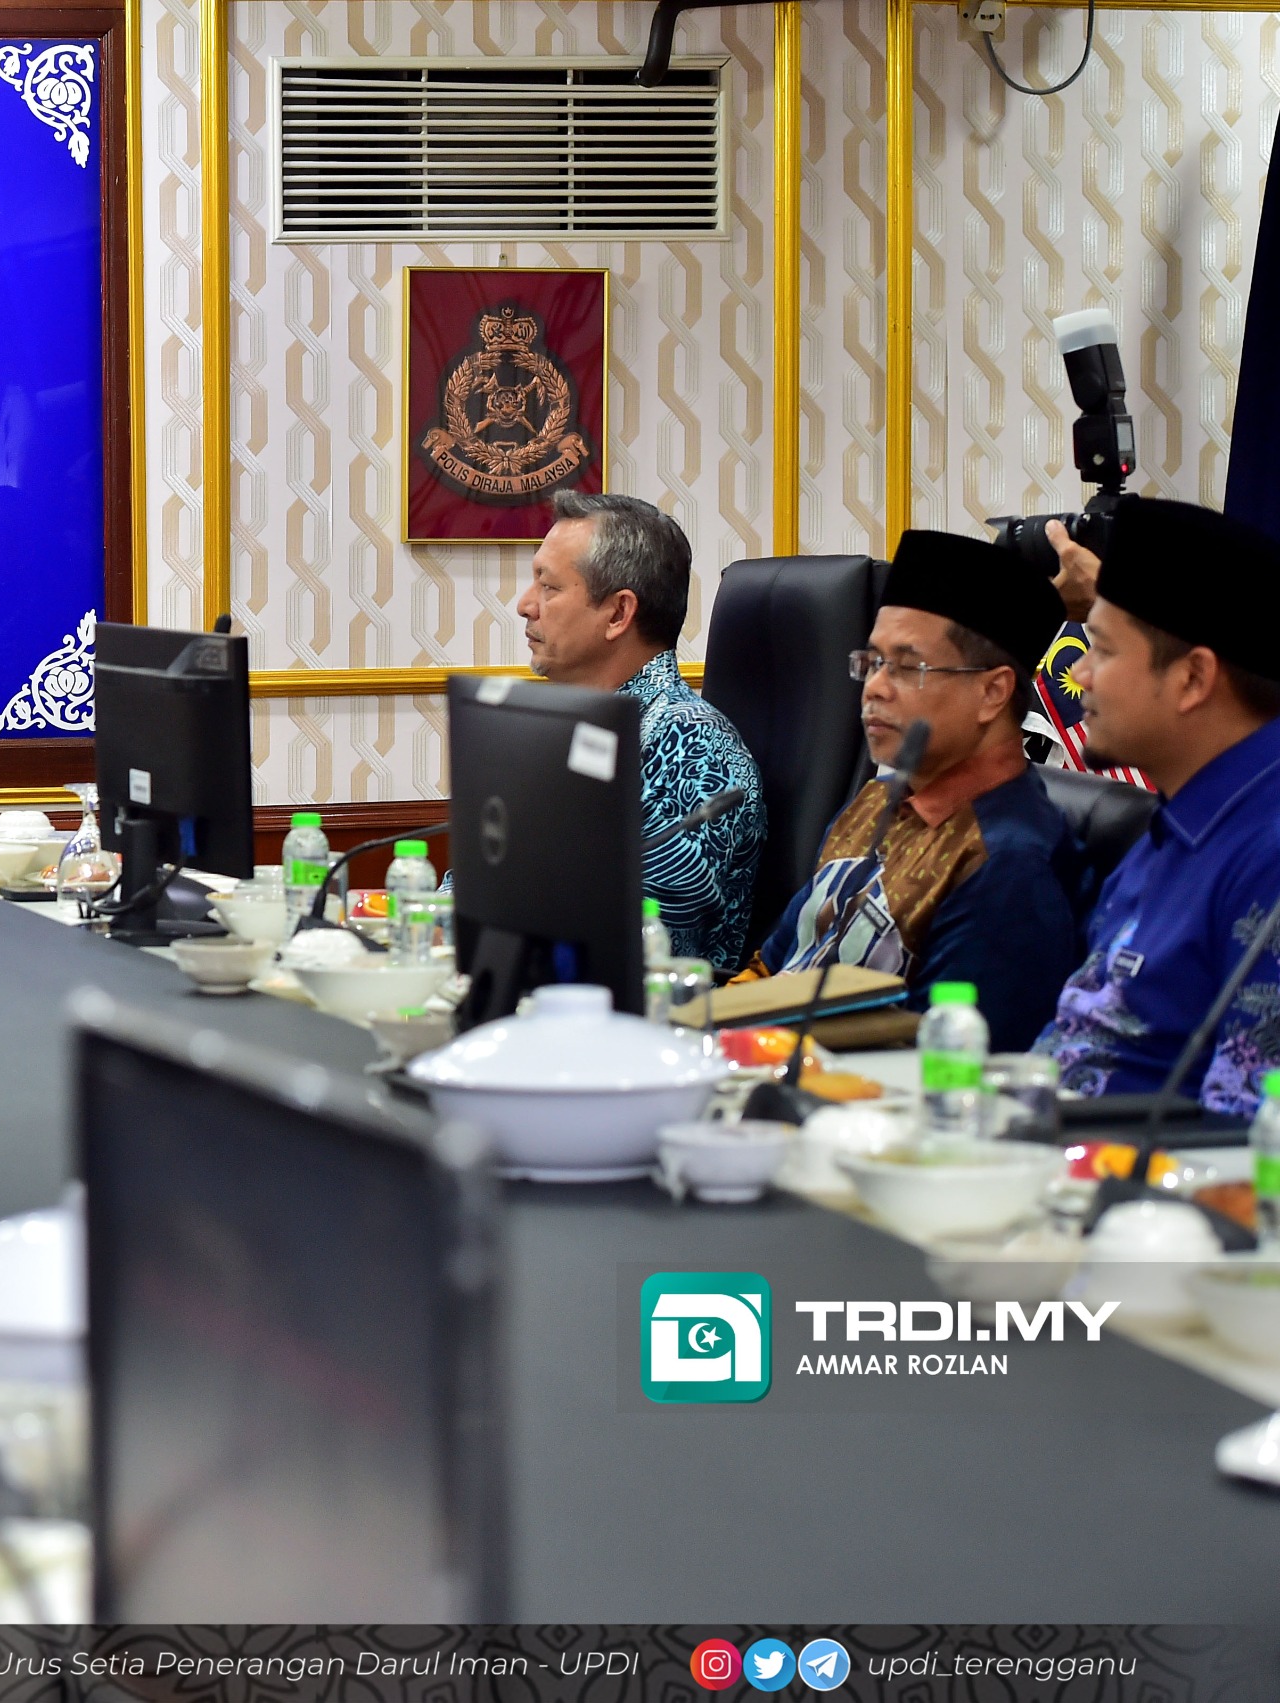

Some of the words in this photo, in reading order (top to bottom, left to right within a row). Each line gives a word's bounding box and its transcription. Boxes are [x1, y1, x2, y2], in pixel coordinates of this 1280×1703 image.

[436, 451, 470, 482] POLIS
[471, 474, 514, 493] DIRAJA
[520, 457, 576, 492] MALAYSIA
